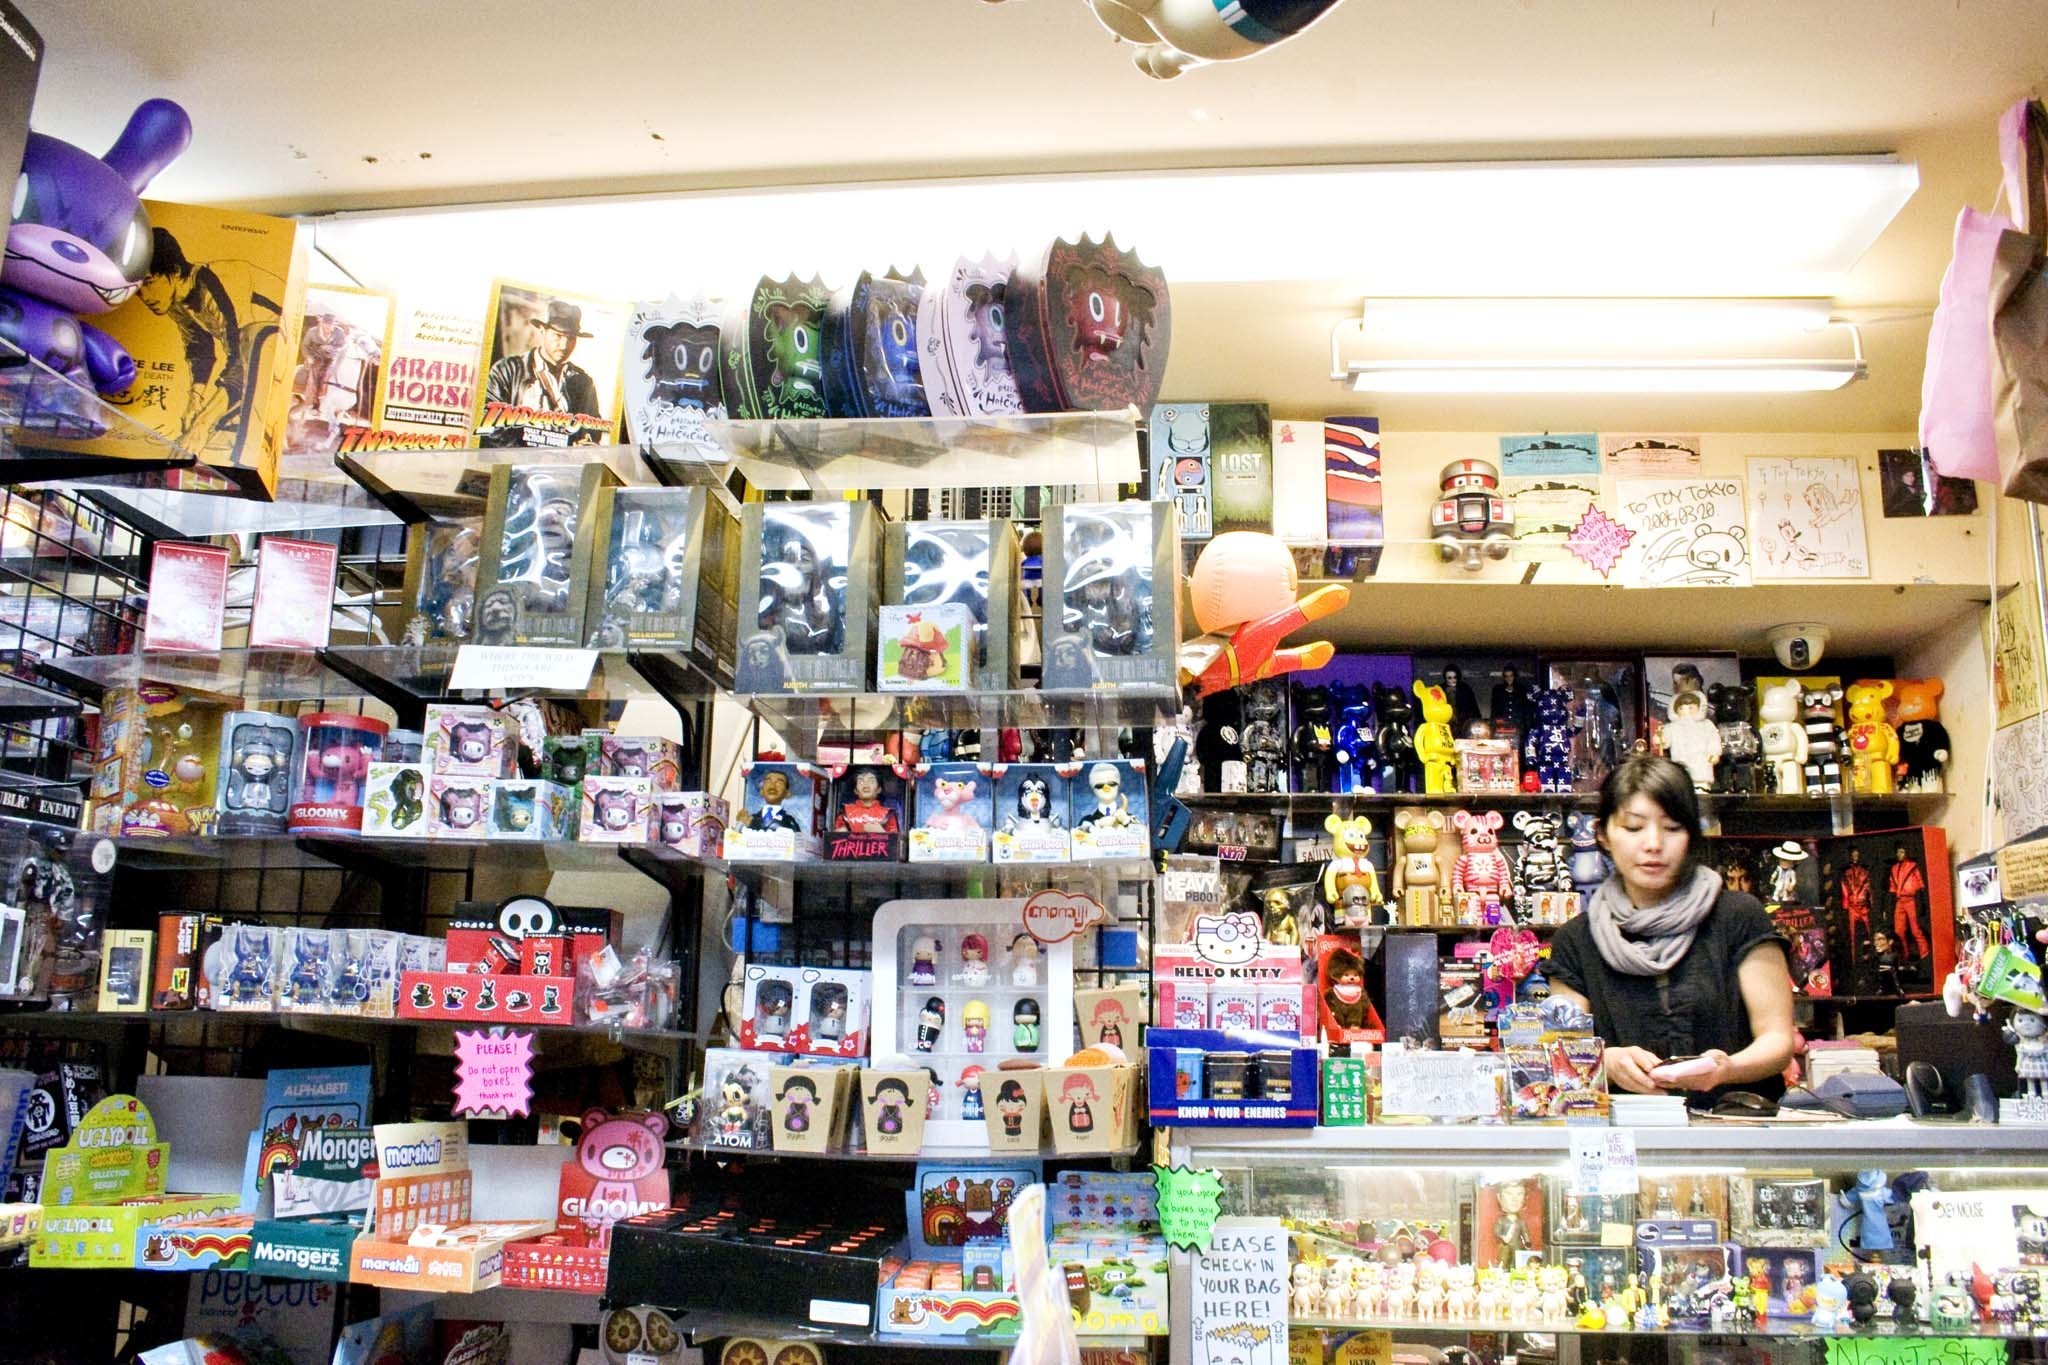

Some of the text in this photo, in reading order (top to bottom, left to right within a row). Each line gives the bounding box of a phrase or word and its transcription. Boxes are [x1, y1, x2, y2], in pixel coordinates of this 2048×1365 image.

[152, 361, 175, 372] LEE
[476, 401, 572, 434] INDIANA
[1220, 452, 1262, 473] LOST
[1650, 490, 1685, 511] TOY
[1685, 481, 1738, 500] TOKYO
[39, 799, 79, 819] ENEMY
[294, 807, 349, 820] GLOOMY
[831, 839, 890, 862] THRILLER
[1166, 873, 1217, 892] HEAVY
[1185, 890, 1219, 902] PB001
[1174, 967, 1282, 979] HELLO KITTY
[232, 1001, 272, 1011] PLUTO
[332, 1004, 361, 1014] PLUTO
[476, 1043, 517, 1055] PLEASE!
[467, 1066, 479, 1075] Do
[482, 1064, 497, 1074] not
[1177, 1106, 1287, 1120] KNOW YOUR ENEMIES
[79, 1126, 149, 1148] UGLYDOLL
[712, 1134, 752, 1148] ATOM
[385, 1136, 441, 1169] marshall
[1176, 1189, 1194, 1198] you
[45, 1217, 114, 1233] UGLYDOLL
[1210, 1236, 1276, 1253] LEASE
[254, 1241, 340, 1269] Mongers
[361, 1256, 420, 1275] marshall
[1200, 1277, 1281, 1295] YOUR BAG
[1204, 1300, 1271, 1319] HERE!
[1345, 1344, 1382, 1356] Kodak
